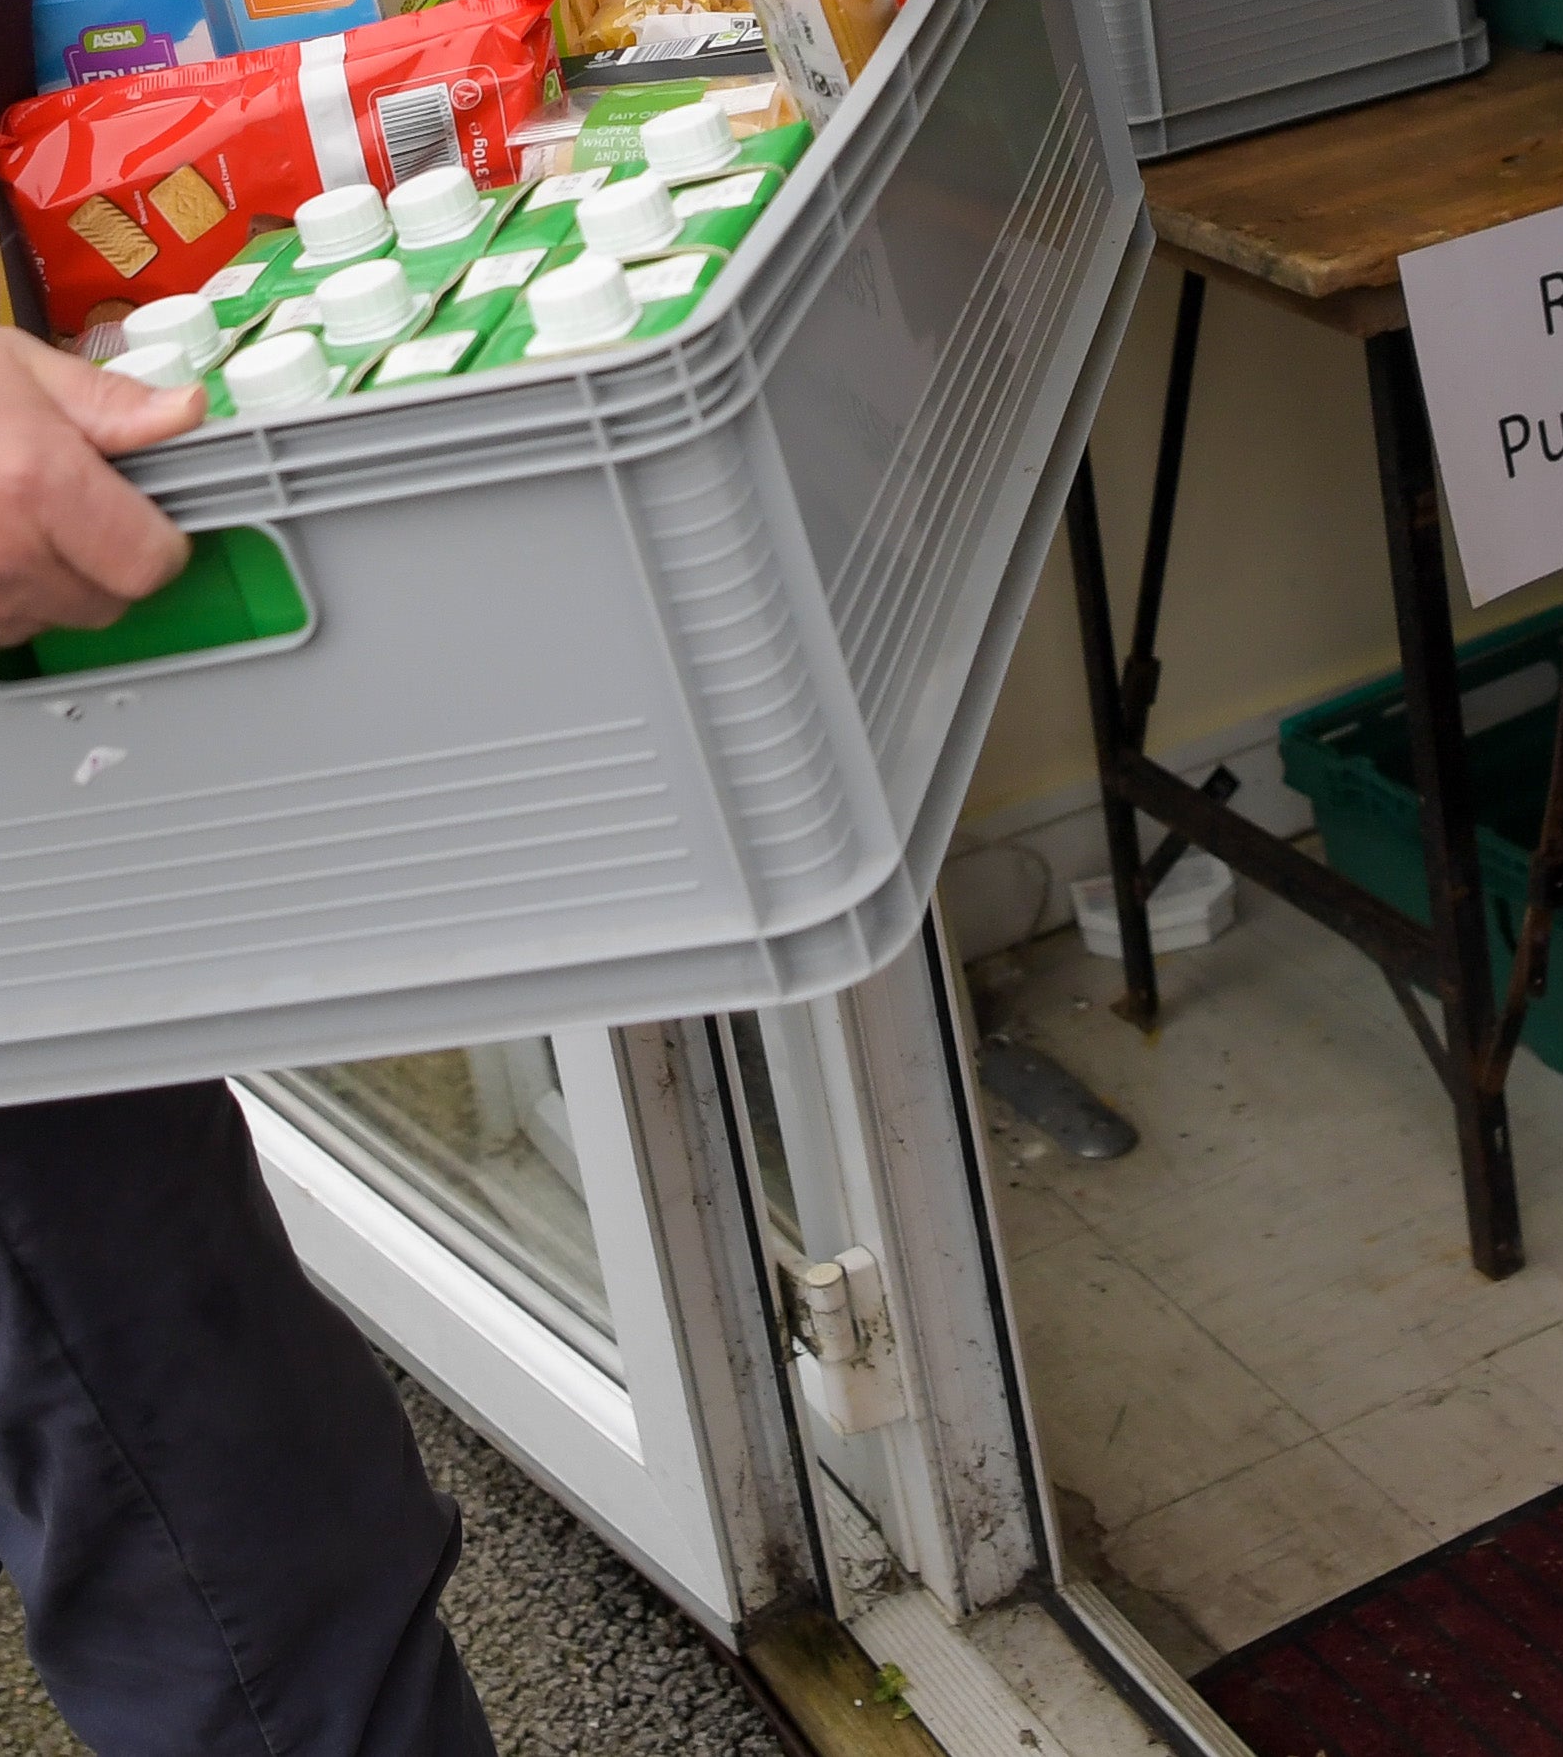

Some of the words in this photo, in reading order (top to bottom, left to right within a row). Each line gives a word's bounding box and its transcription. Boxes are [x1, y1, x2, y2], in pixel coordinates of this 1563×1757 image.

[92, 30, 138, 49] ASDA
[608, 111, 638, 121] EASY
[582, 136, 615, 148] WHAT
[472, 137, 490, 177] 310g
[594, 149, 620, 163] AND
